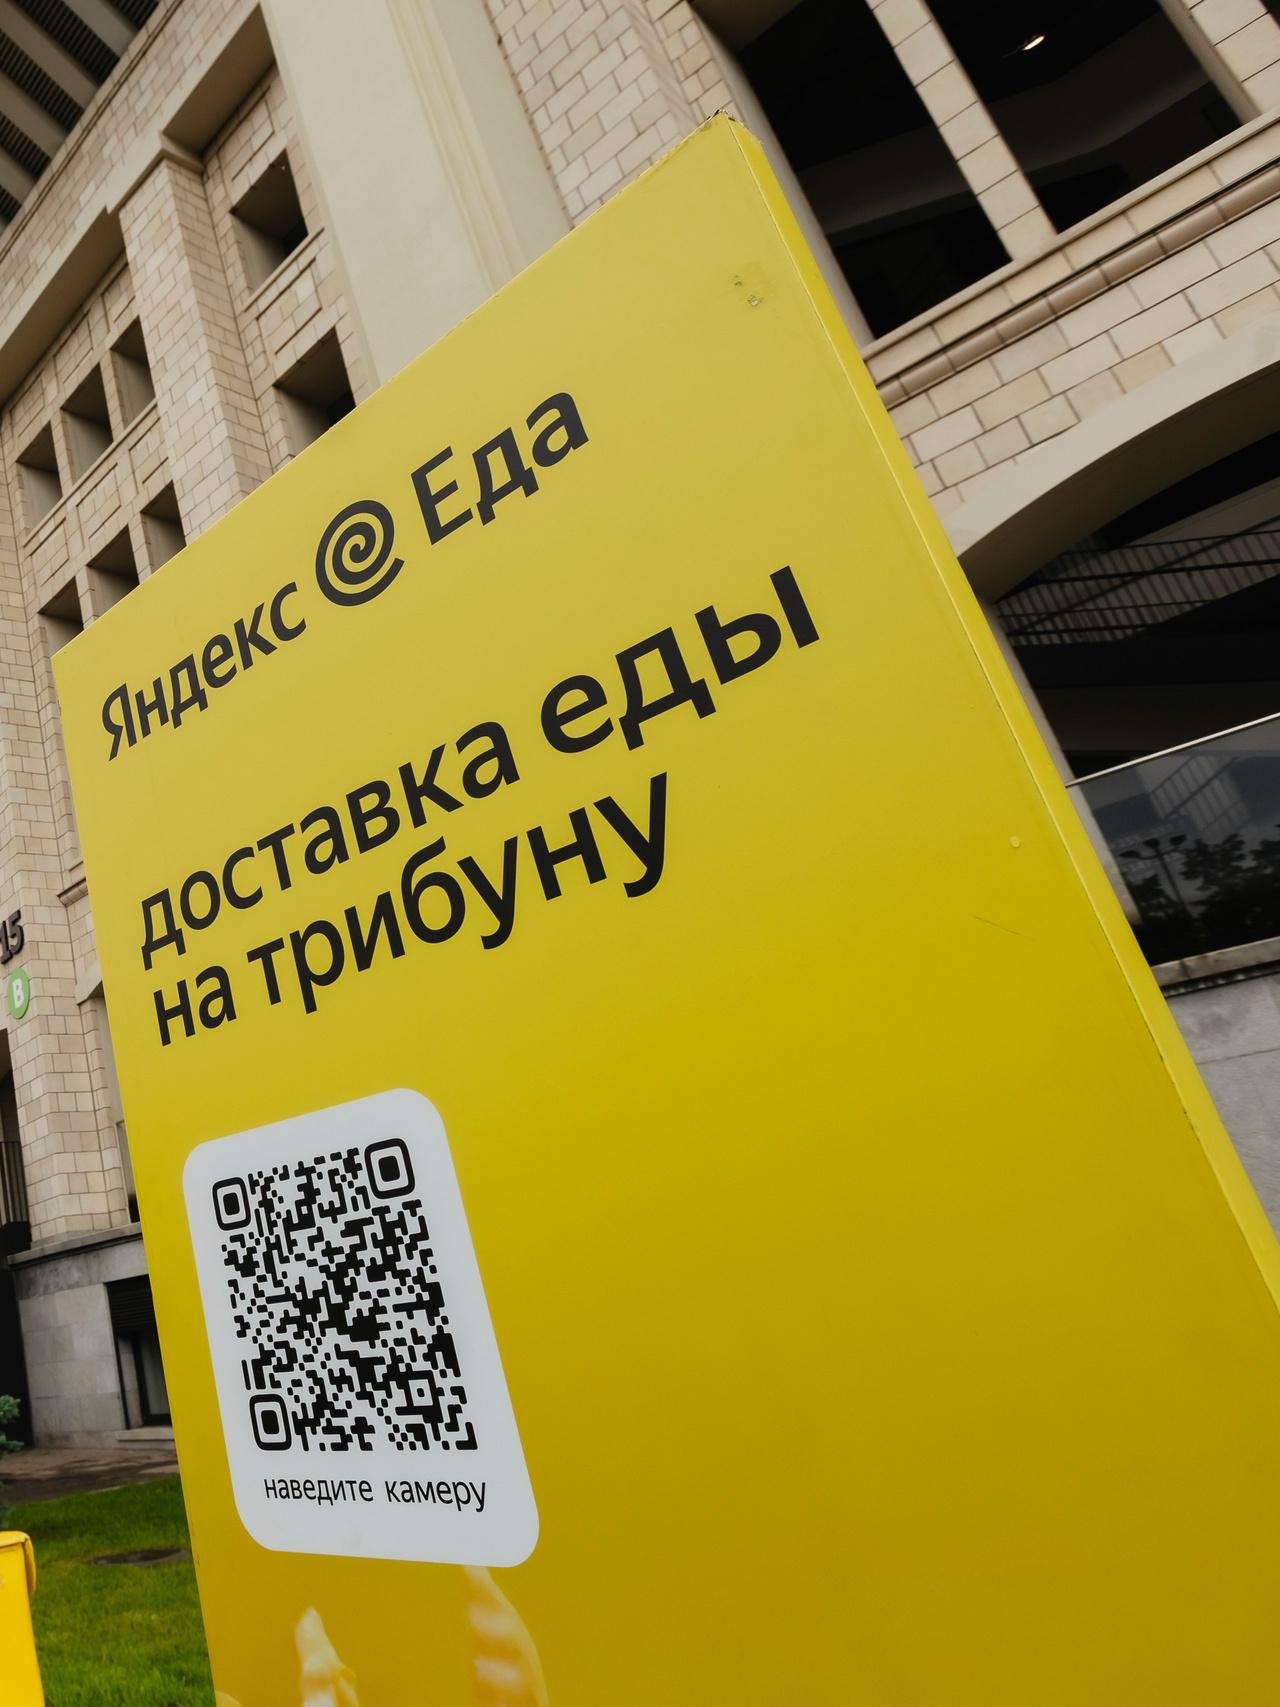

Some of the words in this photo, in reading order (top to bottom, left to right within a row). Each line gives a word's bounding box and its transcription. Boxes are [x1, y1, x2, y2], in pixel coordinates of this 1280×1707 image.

[101, 582, 307, 762] Яндекс
[411, 392, 589, 545] Еда
[141, 721, 520, 970] доставка
[540, 565, 820, 754] еды
[153, 965, 237, 1047] на
[246, 771, 668, 1014] трибуну
[264, 1478, 374, 1506] наведите
[385, 1480, 487, 1513] камеру
